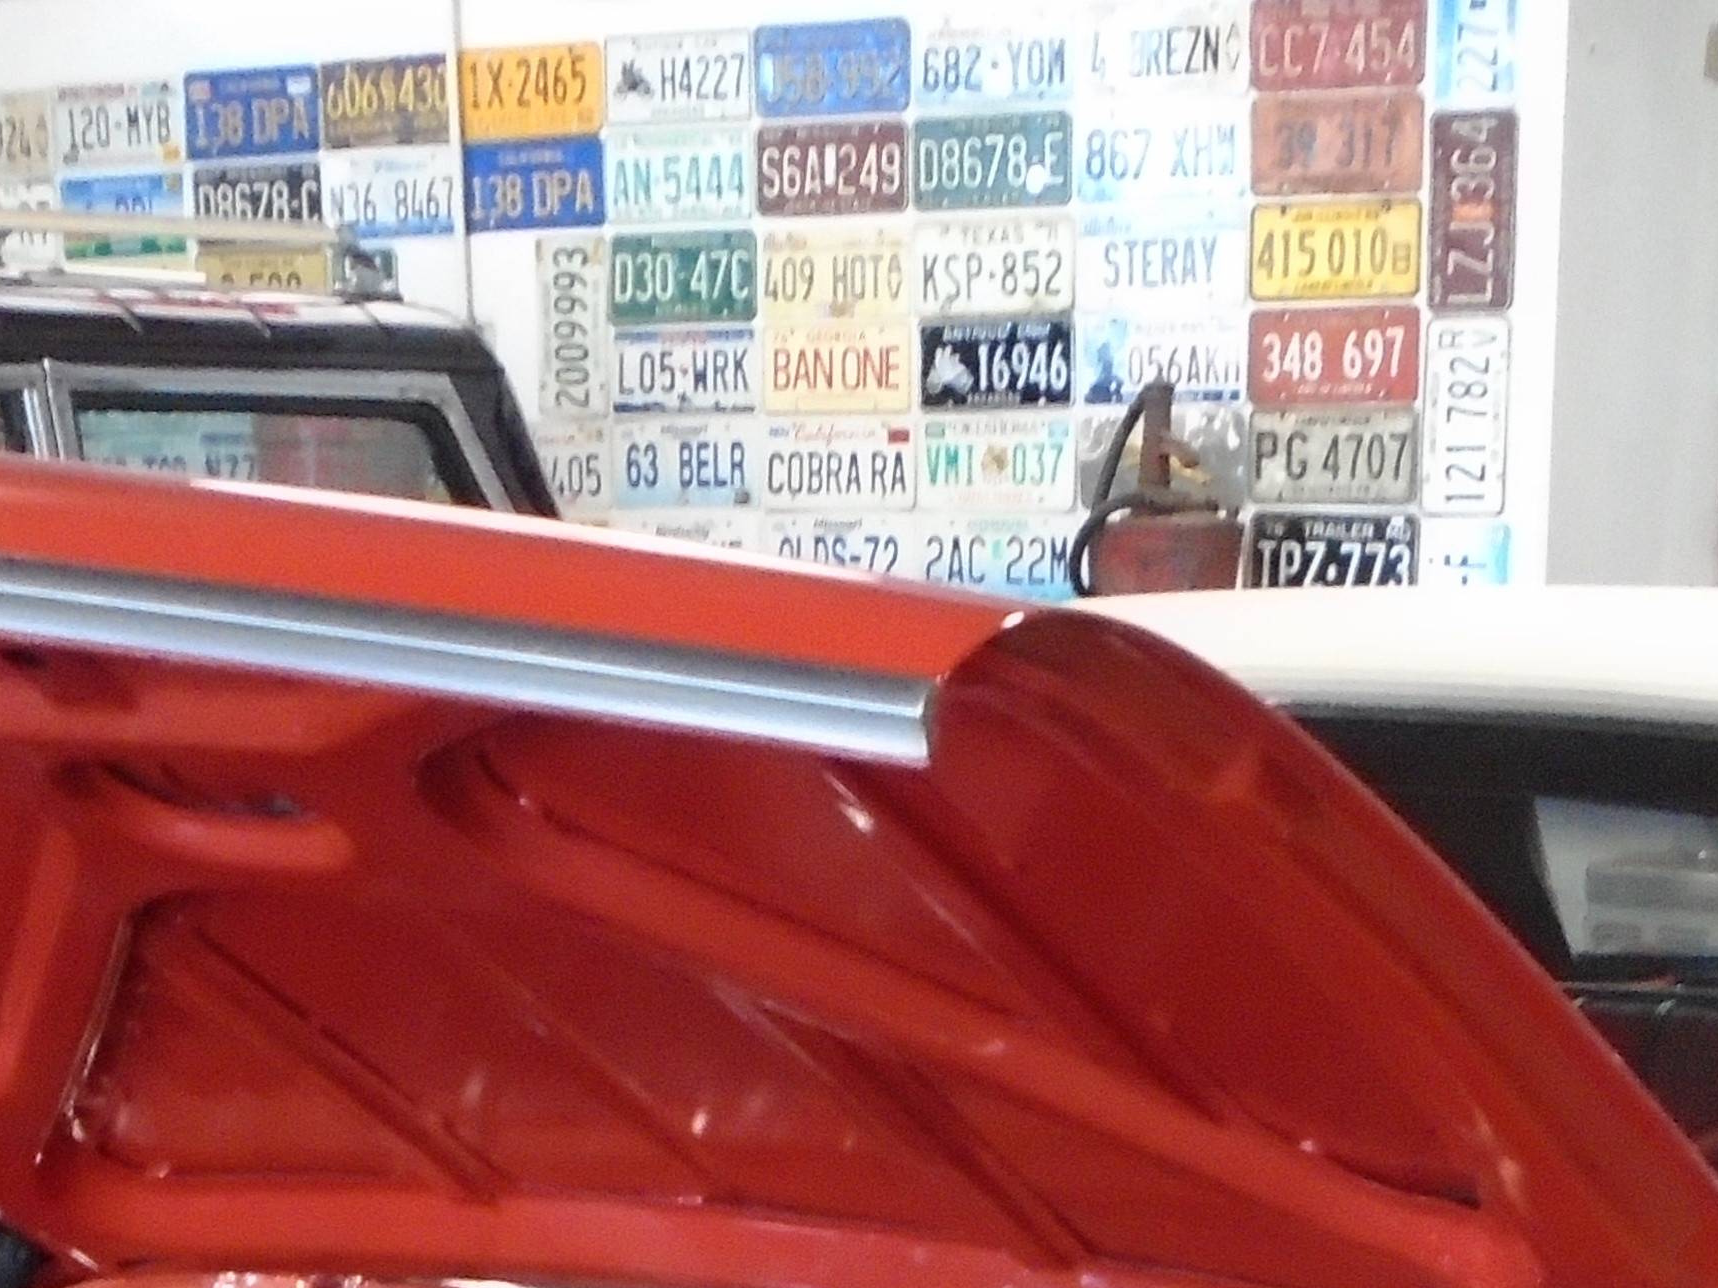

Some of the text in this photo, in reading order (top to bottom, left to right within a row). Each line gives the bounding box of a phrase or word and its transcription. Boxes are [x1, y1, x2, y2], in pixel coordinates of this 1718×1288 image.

[660, 53, 746, 102] H4227
[252, 97, 311, 147] DPA
[838, 141, 900, 195] 249
[1085, 127, 1153, 181] 867
[470, 169, 594, 222] 138 DPA
[960, 221, 1026, 246] TEXAS
[1257, 229, 1318, 281] 415
[1326, 226, 1388, 277] 010
[763, 257, 816, 303] 409
[1102, 235, 1219, 290] STERAY
[773, 345, 900, 392] BAN ONE
[980, 343, 1070, 392] 16946
[1261, 325, 1406, 383] 348 697
[793, 423, 878, 449] California
[1255, 430, 1411, 481] PG 4707
[626, 440, 746, 489] 63 BELR
[766, 449, 909, 496] COBRA RA
[926, 443, 1066, 487] VMI 037
[926, 535, 987, 585] 2AC
